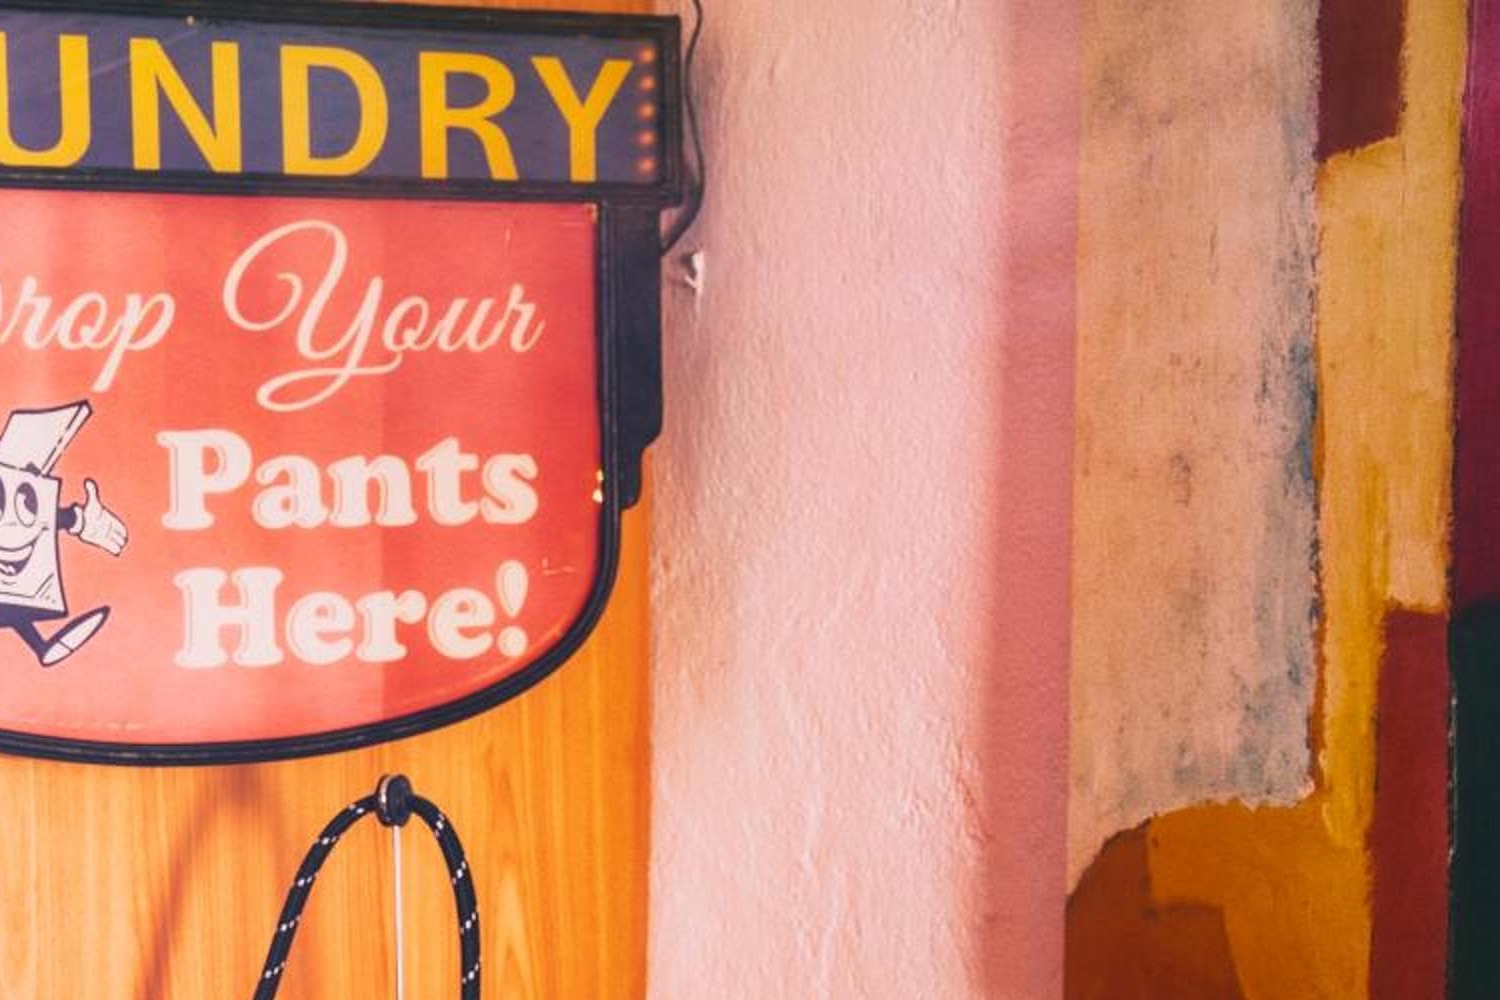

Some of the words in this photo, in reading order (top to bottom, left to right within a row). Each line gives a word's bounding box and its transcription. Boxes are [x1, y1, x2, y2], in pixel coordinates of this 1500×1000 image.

[221, 219, 546, 412] Your
[155, 428, 539, 531] Pants
[172, 560, 528, 669] Here!
